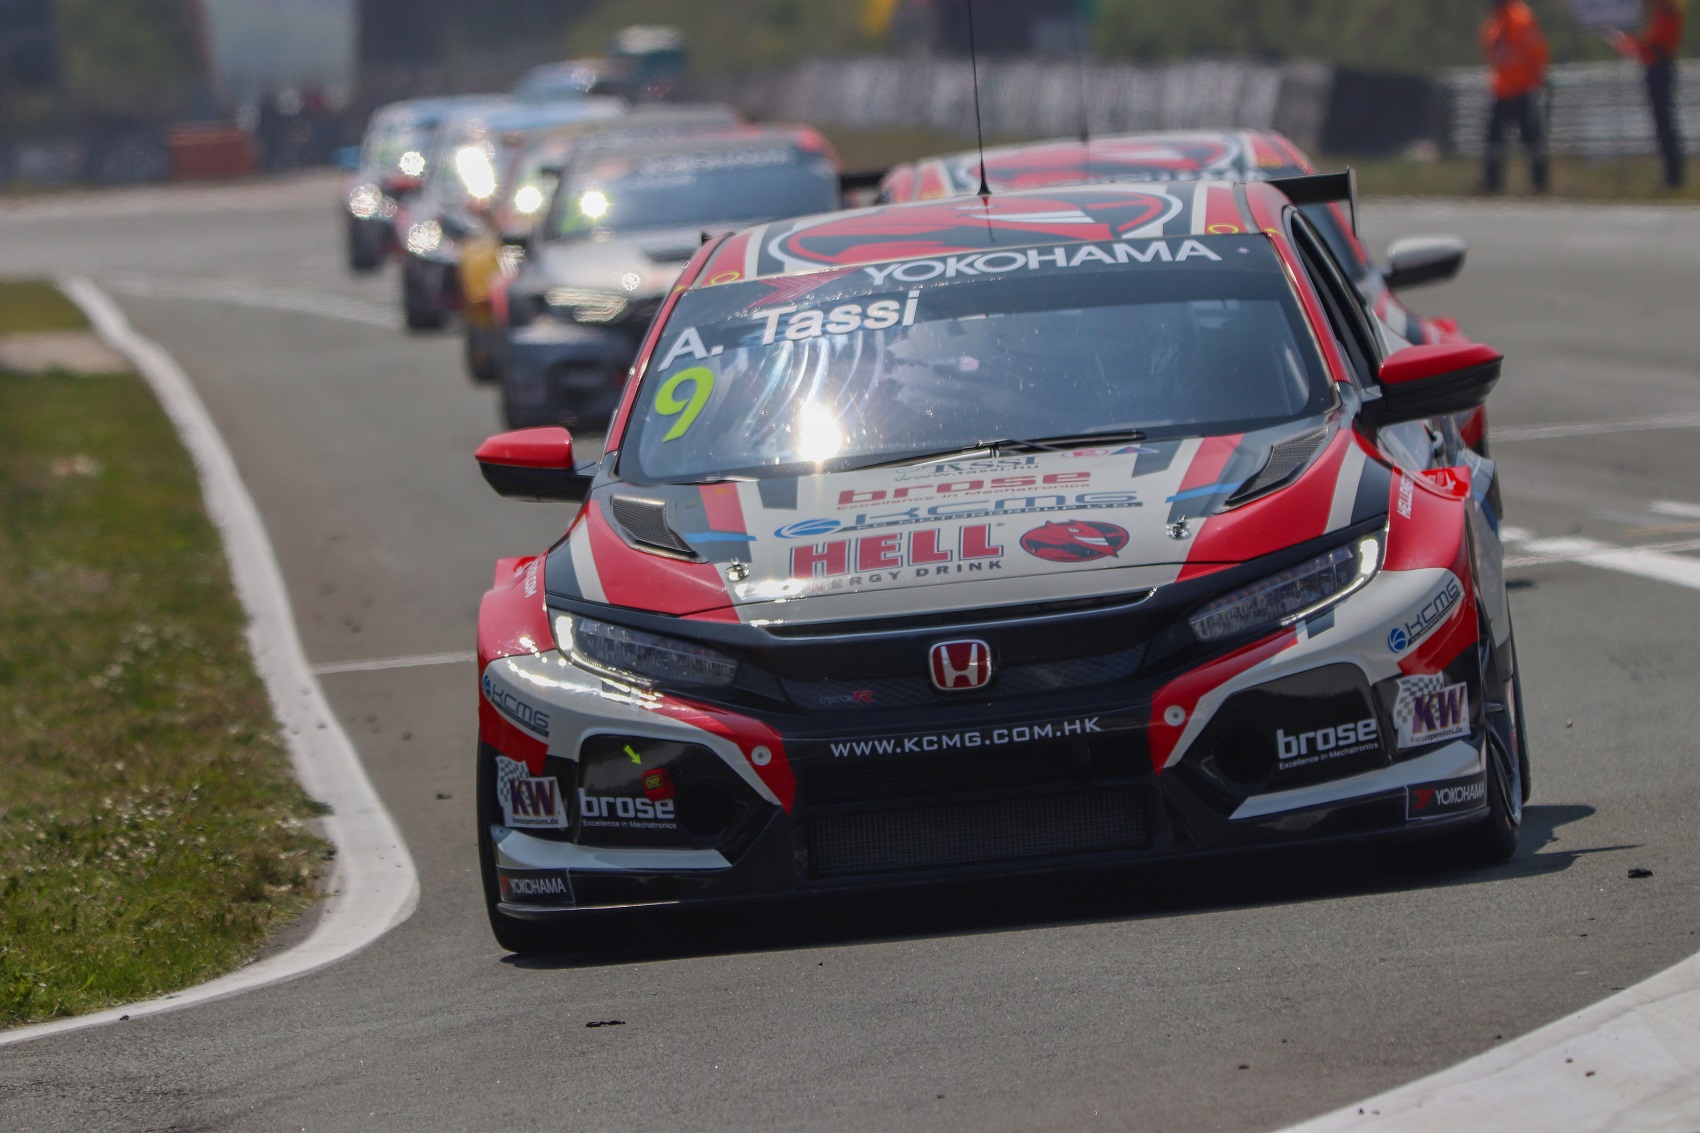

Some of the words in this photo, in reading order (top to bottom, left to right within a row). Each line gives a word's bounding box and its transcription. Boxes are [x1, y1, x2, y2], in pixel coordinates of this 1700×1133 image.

[864, 239, 1223, 286] YOKOHAMA
[658, 326, 724, 372] A.
[752, 290, 921, 345] Tassi
[654, 366, 715, 443] 9
[838, 472, 1092, 505] brose
[790, 523, 1005, 578] HELL
[806, 570, 901, 593] NERGY
[916, 560, 1003, 577] DRINK
[1404, 577, 1460, 637] KCMG
[1411, 685, 1467, 735] KW
[830, 717, 1102, 758] WWW.KCMG.COM.HK
[1276, 718, 1378, 760] brose
[1279, 755, 1320, 771] Excellence
[1329, 742, 1379, 759] Mechatronics
[508, 779, 557, 817] KW
[578, 787, 676, 819] brose
[1434, 780, 1485, 806] YOKOHAMA
[582, 819, 620, 828] Excellence
[629, 821, 678, 830] Mechatronics
[508, 877, 567, 894] YOKOHAMA
